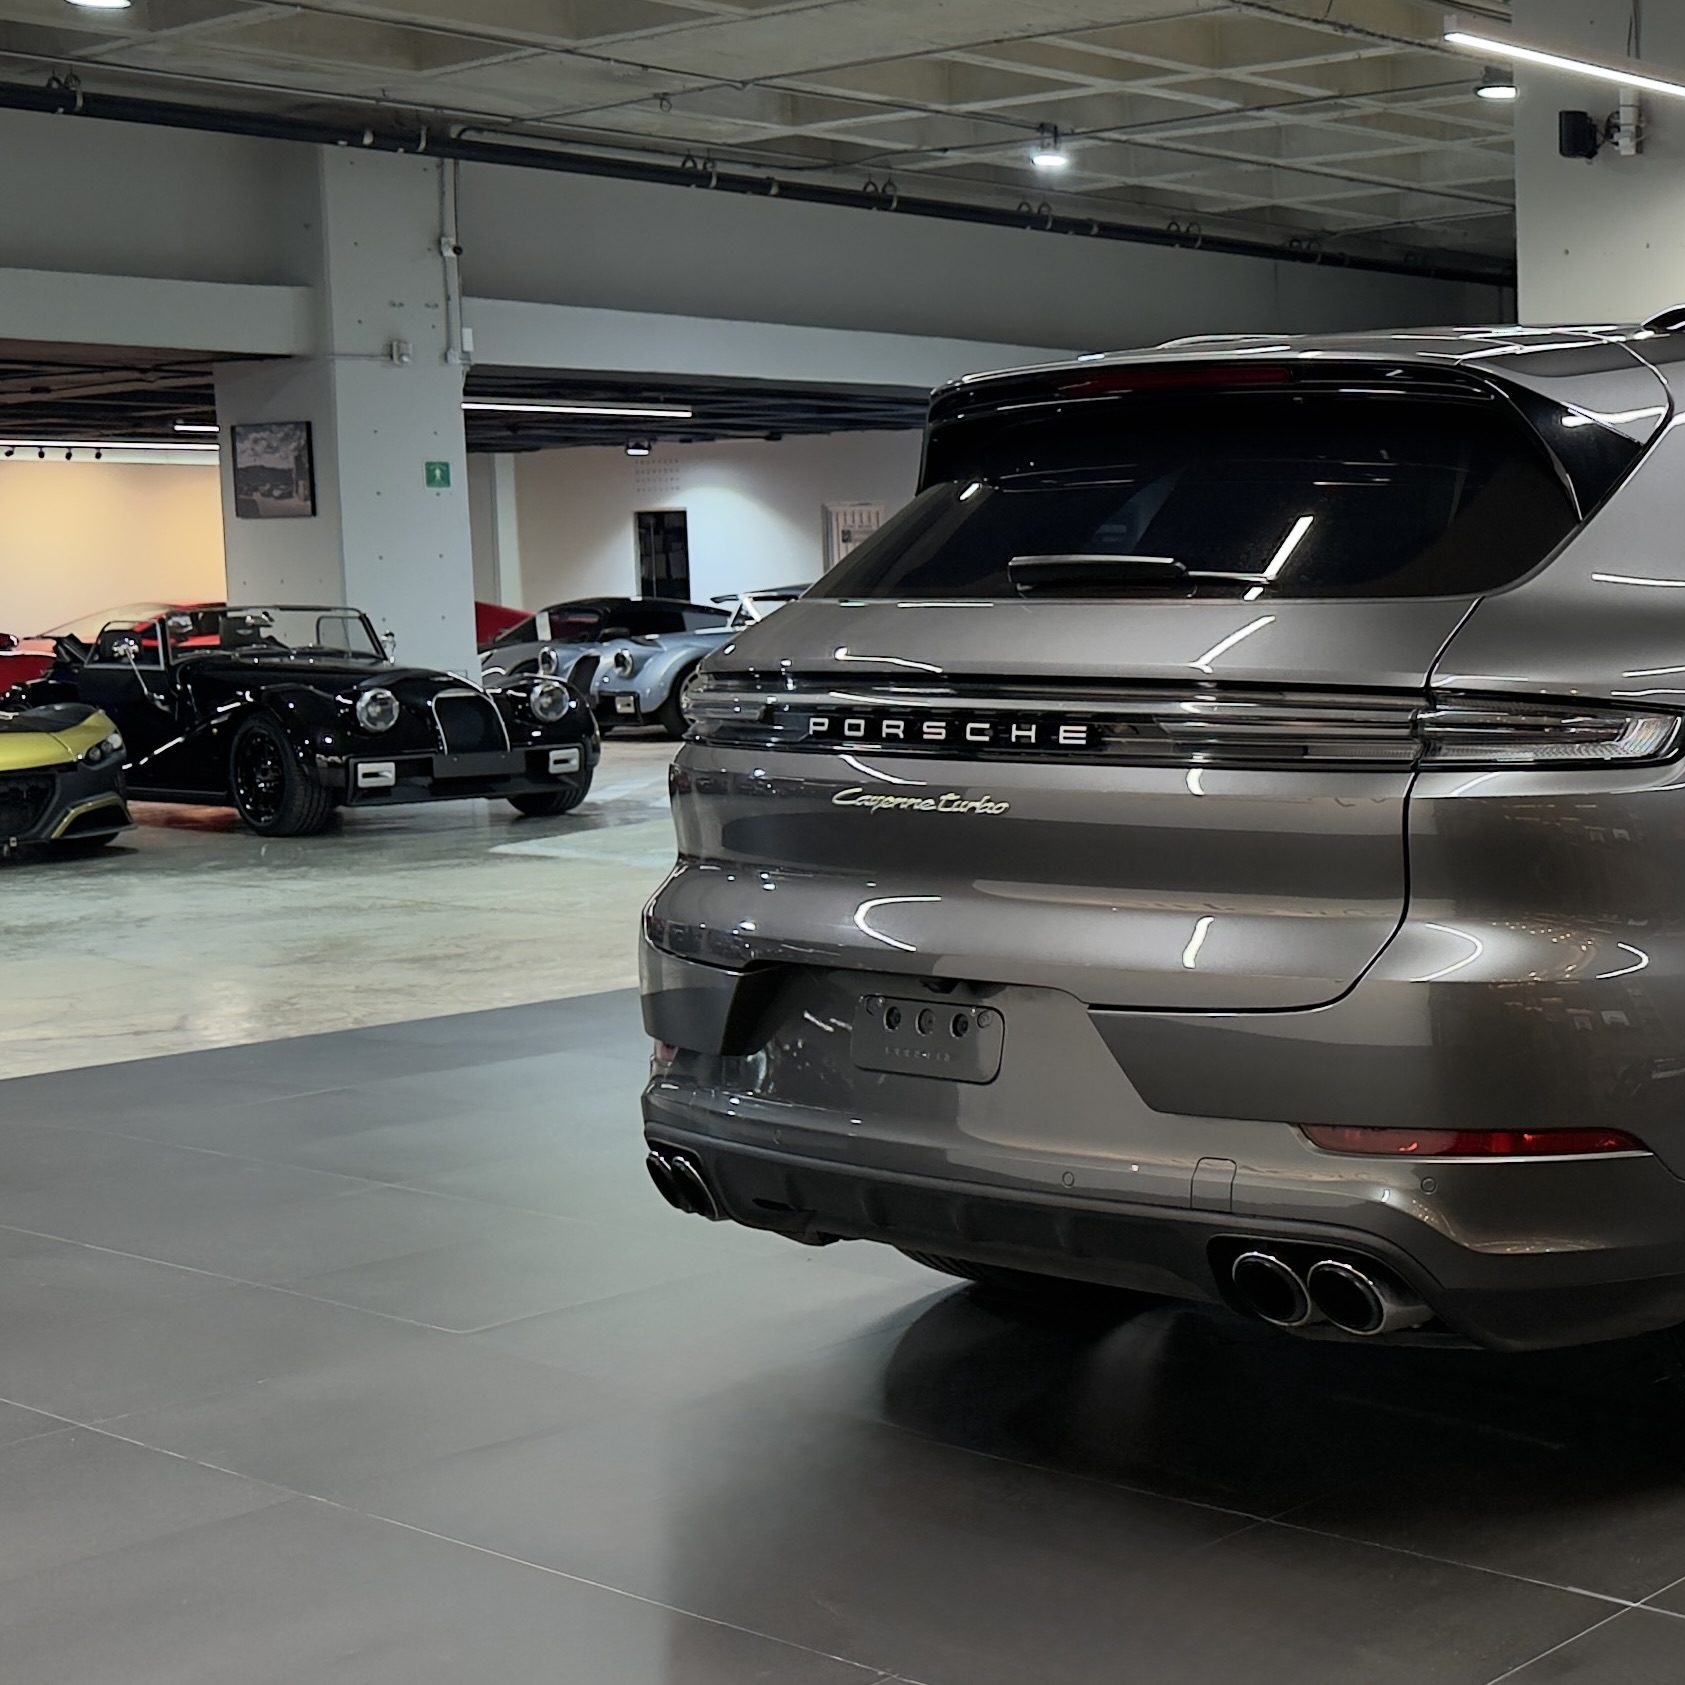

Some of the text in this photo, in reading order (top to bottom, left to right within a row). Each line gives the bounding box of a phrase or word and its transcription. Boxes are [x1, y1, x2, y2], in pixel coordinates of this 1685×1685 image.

[808, 717, 1088, 745] PORSCHE
[831, 787, 1010, 815] Cayenne turbo
